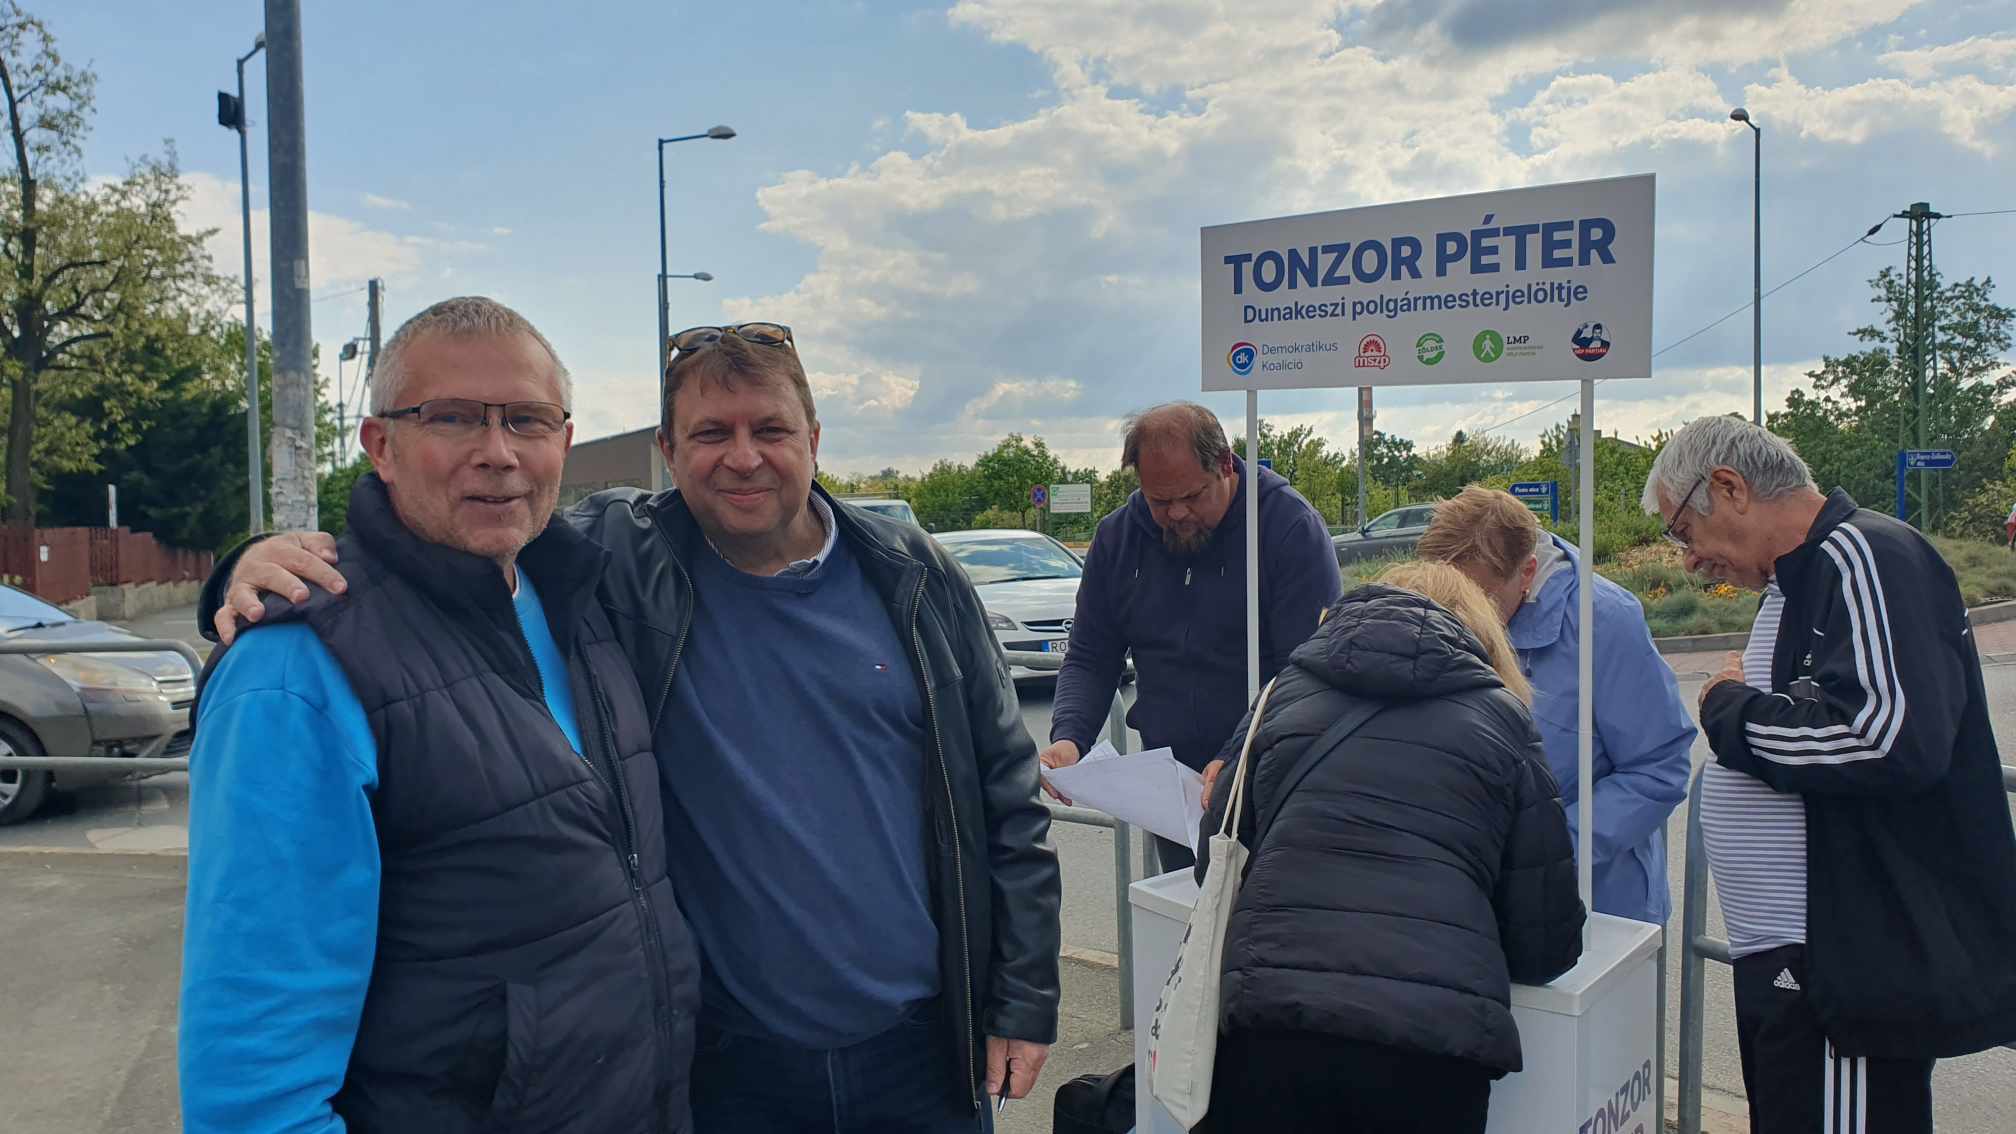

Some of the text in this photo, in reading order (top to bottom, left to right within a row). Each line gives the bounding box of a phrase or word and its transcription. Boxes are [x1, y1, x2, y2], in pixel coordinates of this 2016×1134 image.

[1224, 213, 1617, 295] TONZOR PÉTER
[1243, 280, 1589, 324] Dunakeszi polgármesterjelöltje
[1506, 335, 1530, 345] LMP
[1262, 340, 1339, 355] Demokratikus
[1236, 352, 1249, 364] dk
[1355, 355, 1390, 369] mszp
